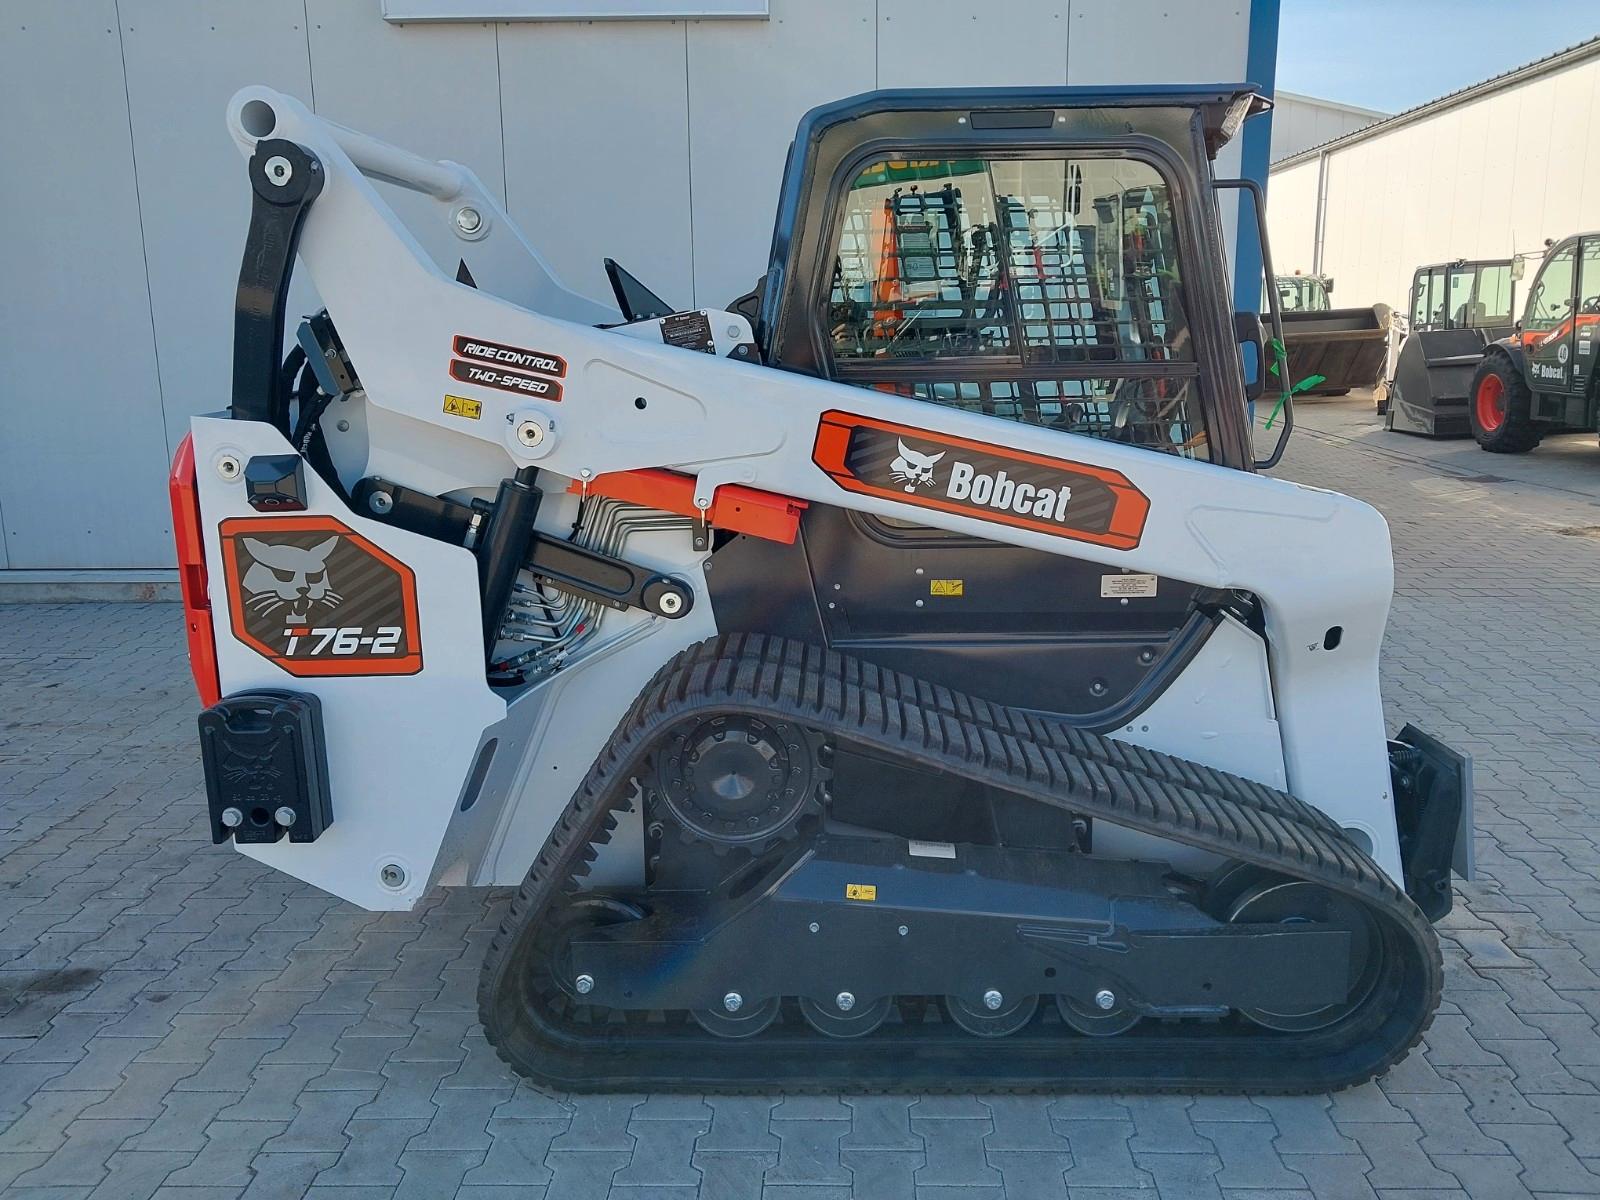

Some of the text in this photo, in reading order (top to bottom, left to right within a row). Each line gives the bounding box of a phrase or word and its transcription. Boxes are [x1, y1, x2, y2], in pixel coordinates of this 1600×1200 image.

[463, 343, 559, 372] RIDE CONTROL
[1541, 364, 1564, 379] Bobcat
[468, 368, 550, 394] TWO-SPEED
[946, 461, 1072, 522] Bobcat
[284, 626, 402, 656] T76-2
